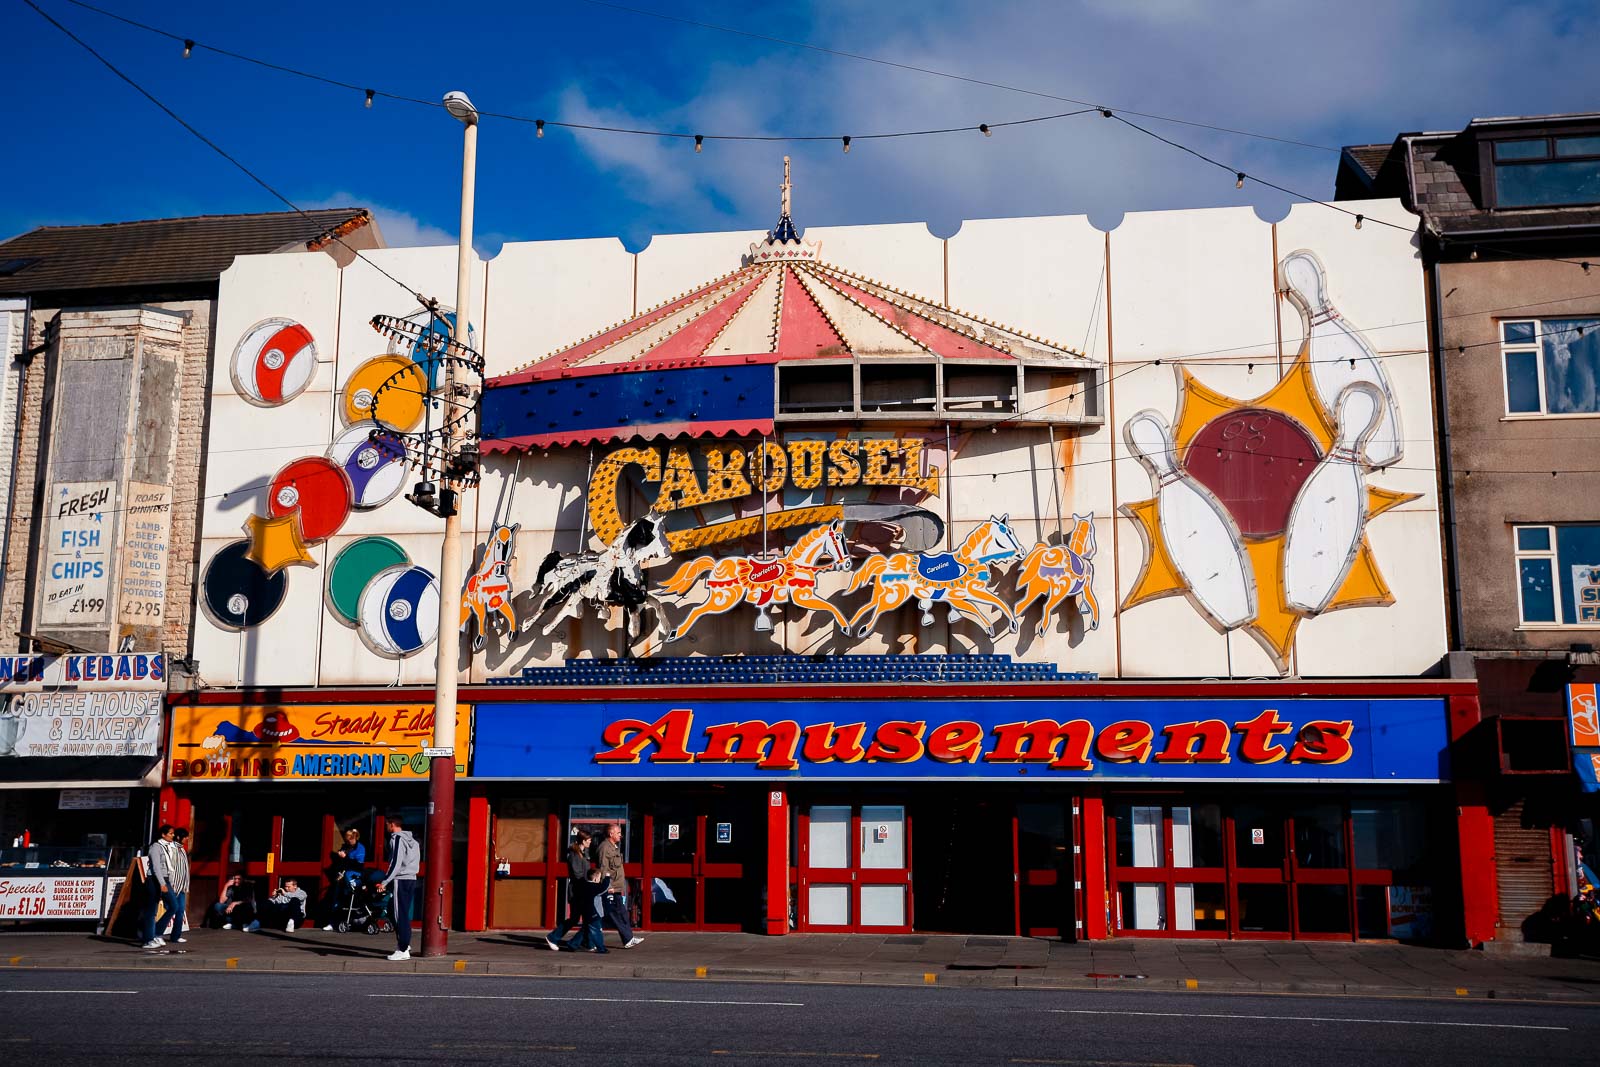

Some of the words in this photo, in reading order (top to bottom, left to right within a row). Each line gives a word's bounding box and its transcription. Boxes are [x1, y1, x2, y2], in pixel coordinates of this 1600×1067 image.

[135, 493, 165, 503] ROAST
[588, 437, 941, 548] CAROUSEL
[58, 487, 110, 520] FRESH
[129, 503, 170, 515] DINNERS
[135, 521, 160, 531] LAMB
[61, 529, 101, 548] FISH
[136, 531, 158, 541] BEEF
[128, 540, 165, 552] CHICKEN
[75, 550, 82, 560] &
[134, 550, 140, 559] 3
[143, 551, 159, 561] VEG
[51, 561, 104, 580] CHIPS
[129, 560, 161, 570] BOILED
[926, 561, 950, 574] Caroline
[124, 578, 162, 589] CHIPPED
[48, 592, 57, 602] TO
[59, 587, 73, 599] EAT
[74, 583, 85, 594] IN
[123, 588, 164, 598] POTATOES
[0, 656, 45, 682] NER
[65, 654, 164, 682] KEBABS
[10, 692, 87, 718] COFFEE
[90, 691, 161, 717] HOUSE
[49, 716, 63, 741] &
[68, 716, 151, 741] BAKERY
[311, 709, 387, 741] Steady
[594, 708, 1354, 771] Amusements
[29, 743, 60, 756] TAKE
[61, 743, 94, 756] AWAY
[95, 743, 113, 755] OR
[115, 743, 138, 755] EAT
[139, 742, 153, 754] IN
[171, 756, 290, 778] BOWLING
[291, 752, 386, 777] AMERICAN
[388, 752, 465, 775] PO
[0, 880, 47, 898] Specials
[7, 905, 16, 916] at
[18, 896, 46, 916] £1.50
[58, 901, 67, 909] PIE
[72, 901, 87, 909] CHIPS
